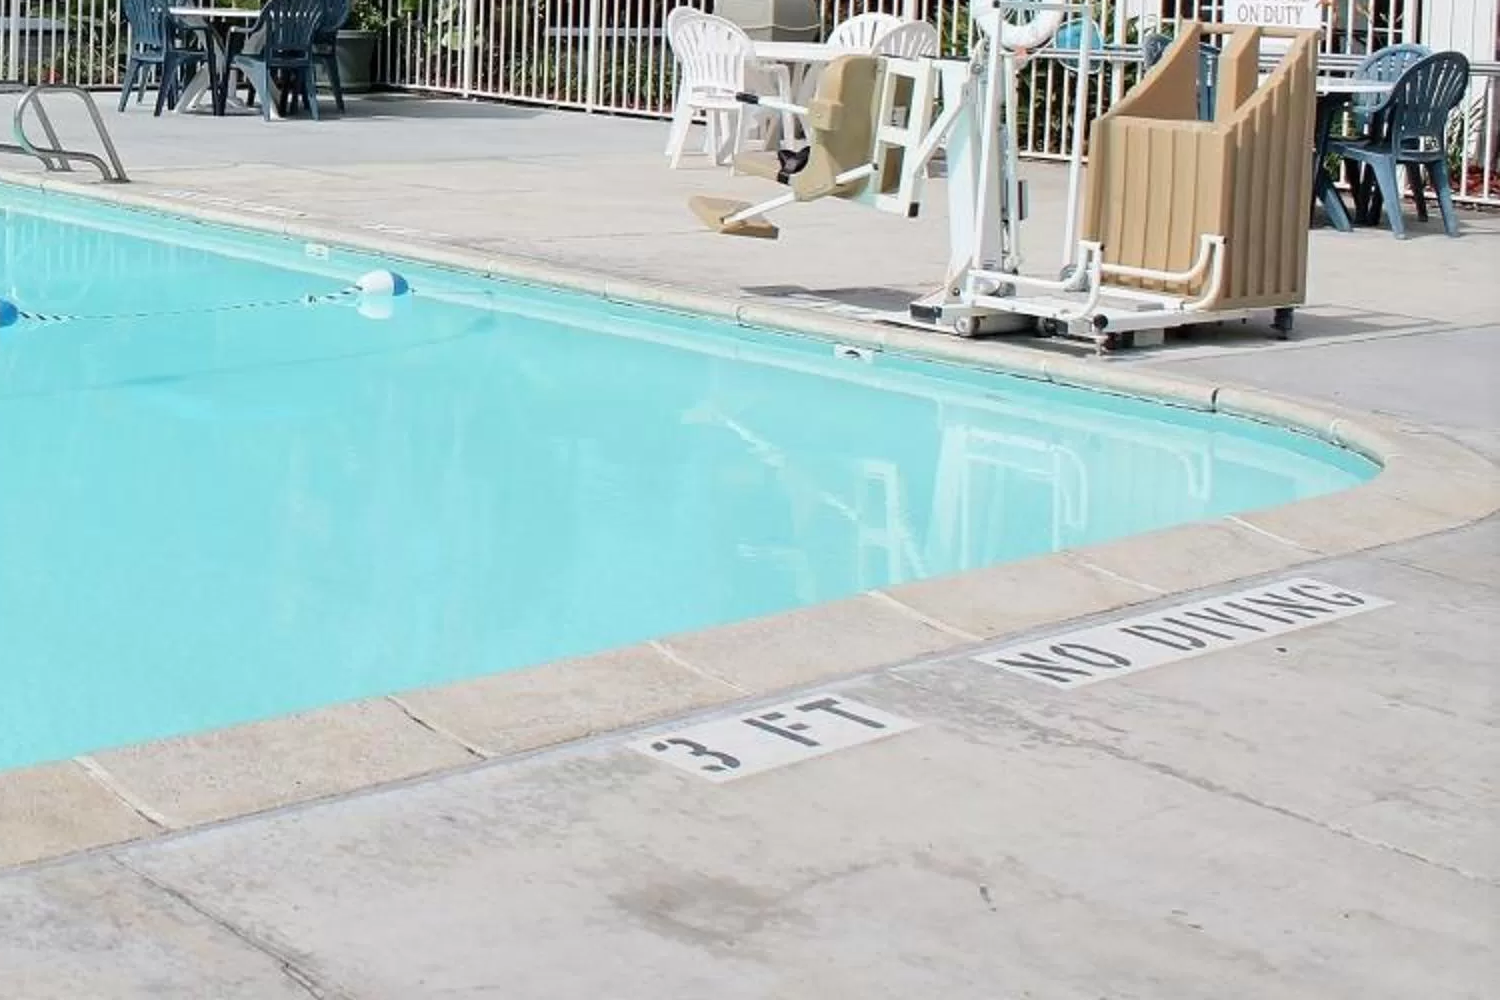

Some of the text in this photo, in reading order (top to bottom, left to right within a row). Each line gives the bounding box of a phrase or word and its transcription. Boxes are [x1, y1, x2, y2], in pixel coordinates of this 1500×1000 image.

[1237, 4, 1304, 25] ON DUTY
[998, 584, 1366, 683] NO DIVING
[651, 697, 887, 772] 3 FT
